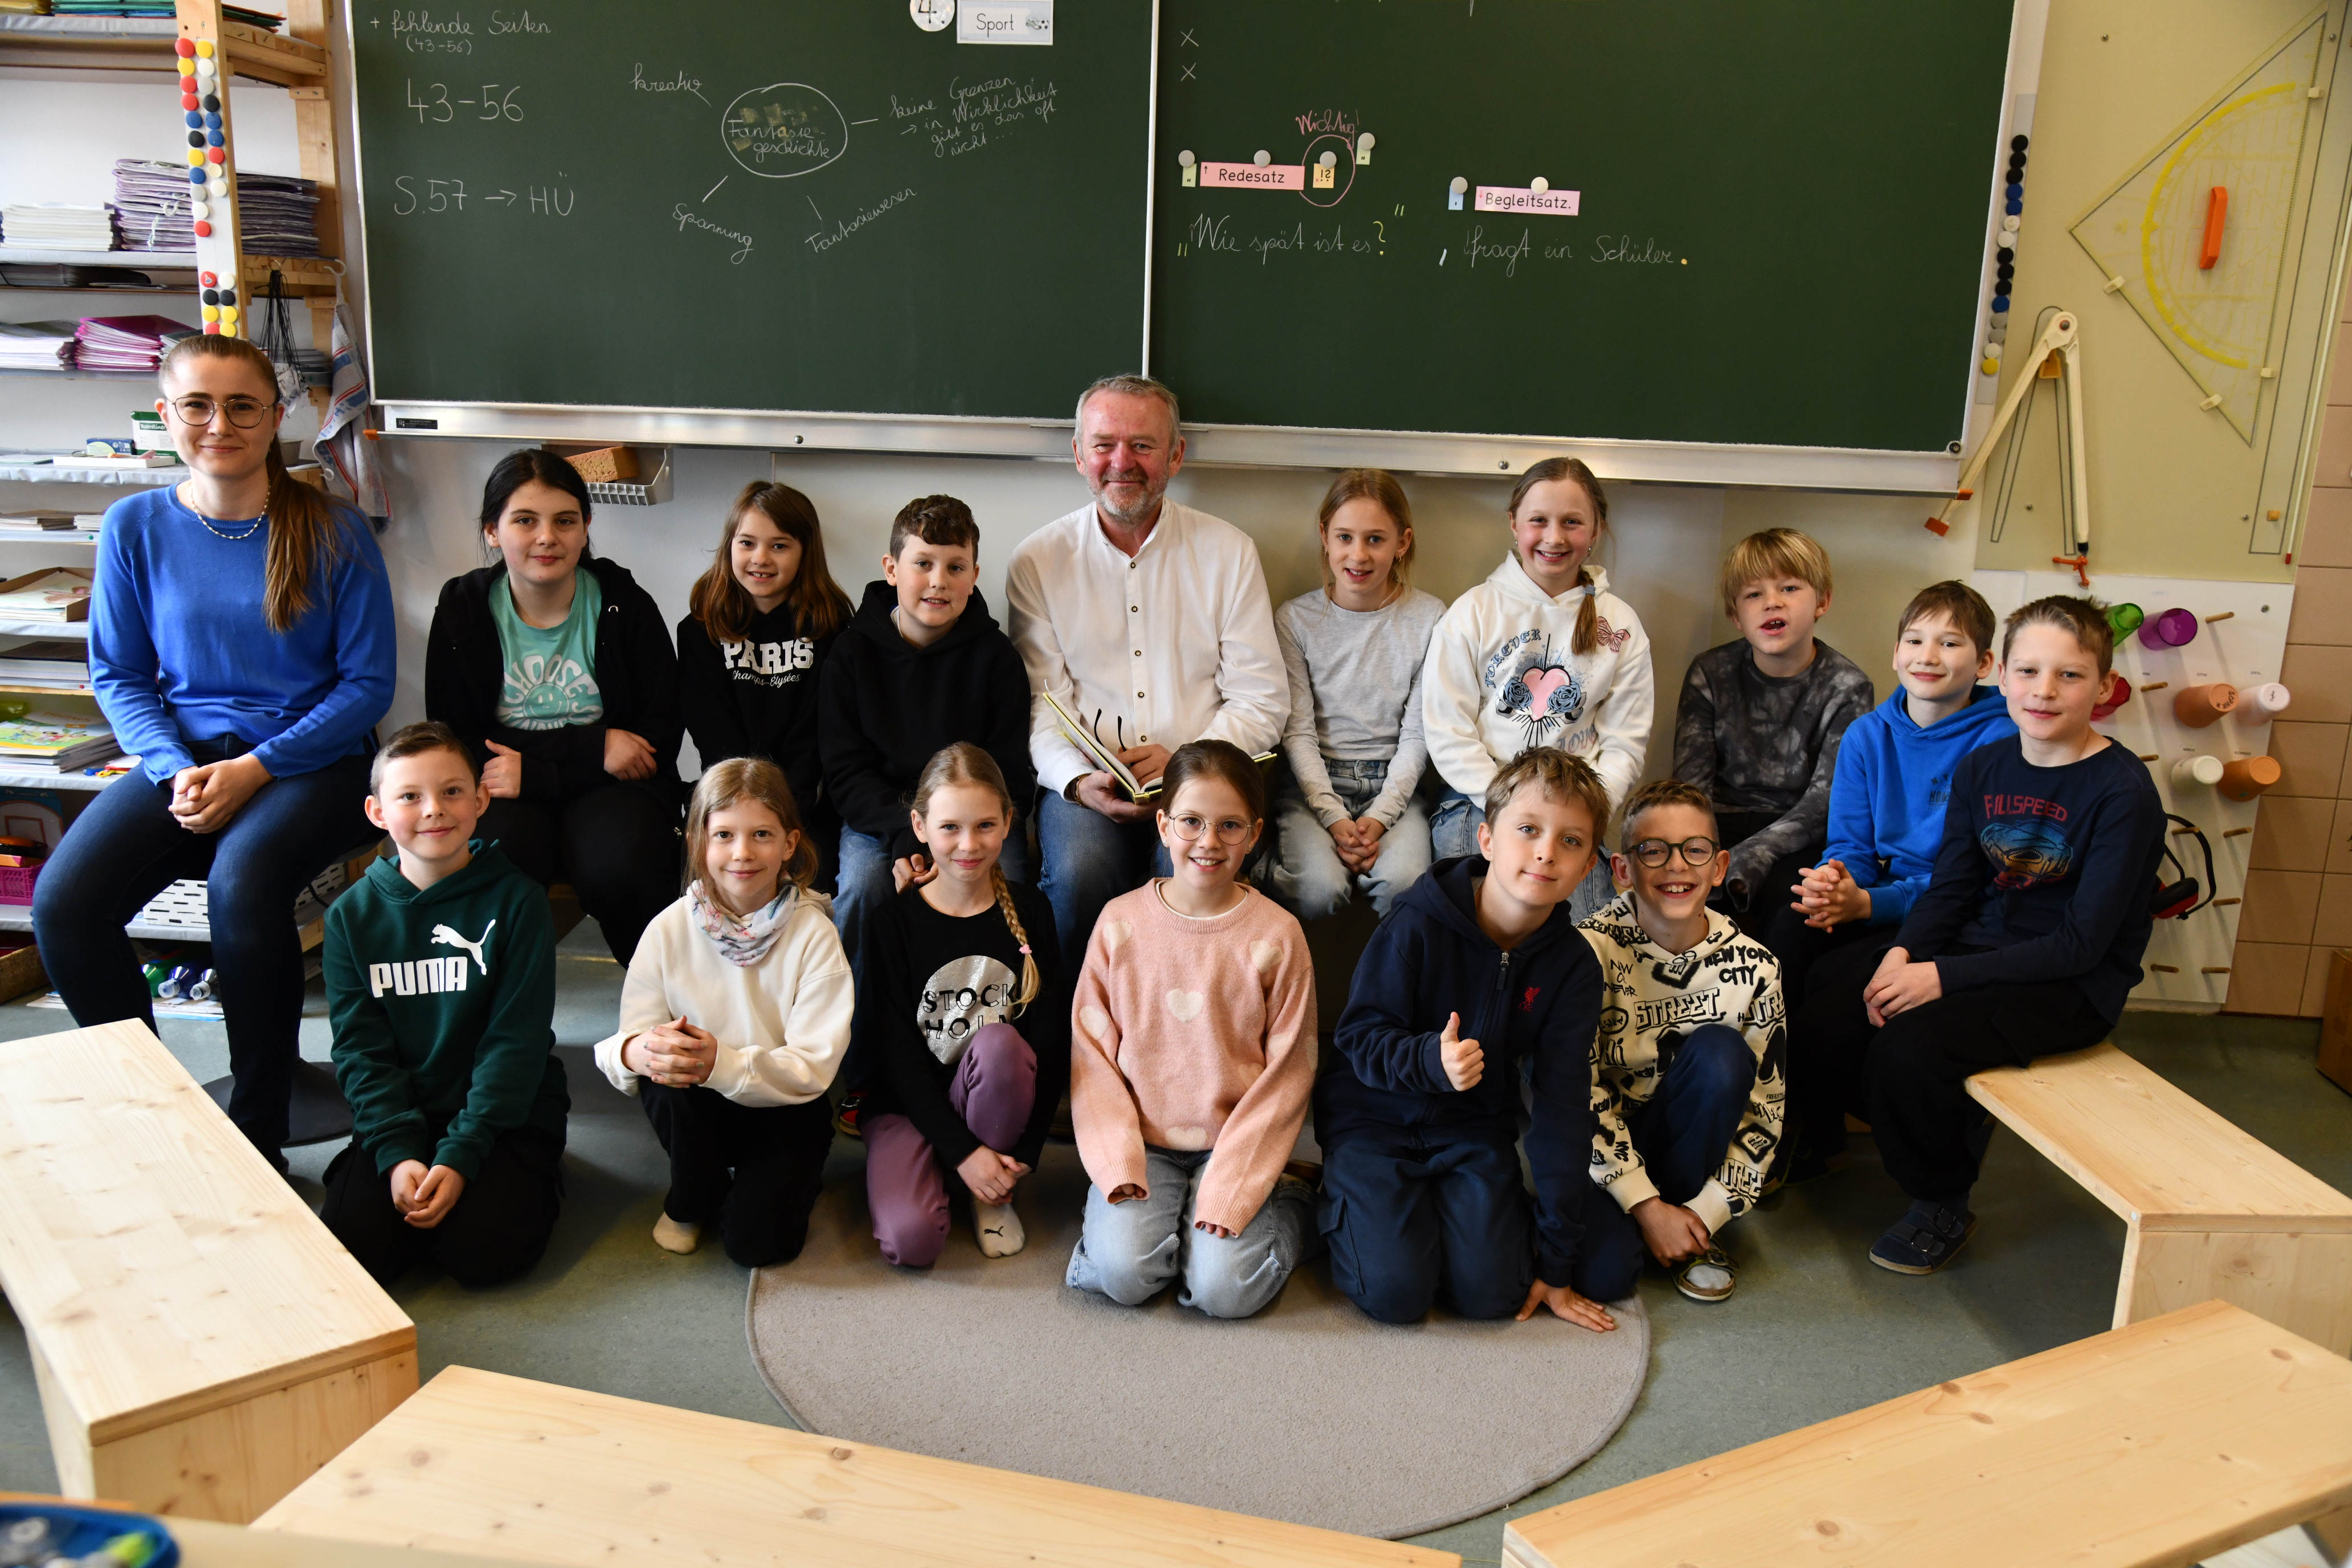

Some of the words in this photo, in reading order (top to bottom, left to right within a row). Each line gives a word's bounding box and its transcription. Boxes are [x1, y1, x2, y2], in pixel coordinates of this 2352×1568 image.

[392, 10, 474, 39] fehlende
[488, 10, 551, 34] Seiten
[977, 13, 1014, 38] Sport
[406, 35, 472, 55] (43-56)
[630, 63, 703, 92] kreativ
[890, 95, 938, 119] keine
[950, 76, 1016, 100] Grenzen
[408, 78, 524, 124] 43-56
[924, 117, 943, 130] in
[952, 78, 1058, 124] Wirklichkeit
[931, 126, 961, 157] gibt
[971, 122, 984, 132] es
[1035, 98, 1057, 124] oft
[950, 132, 987, 156] nicht
[753, 140, 830, 164] geschichte
[394, 175, 467, 215] S.57
[529, 172, 574, 215] HÜ
[1219, 169, 1285, 183] Redesatz
[672, 203, 754, 264] Spannung
[805, 187, 917, 253] Fantasiewesen
[1249, 222, 1305, 265] spät
[1314, 224, 1344, 252] ist
[1471, 224, 1531, 277] fragt
[1545, 238, 1573, 259] ein
[720, 636, 814, 675] PARIS
[1484, 628, 1542, 689] FOREVER
[503, 654, 599, 704] CHOOSE
[369, 956, 468, 998] PUMA
[1610, 959, 1634, 974] NW
[1718, 963, 1758, 986] CITY
[923, 983, 1016, 1014] STOCK
[1604, 981, 1638, 998] NEVER
[1634, 987, 1720, 1030] STREET
[1596, 1168, 1623, 1190] NOW
